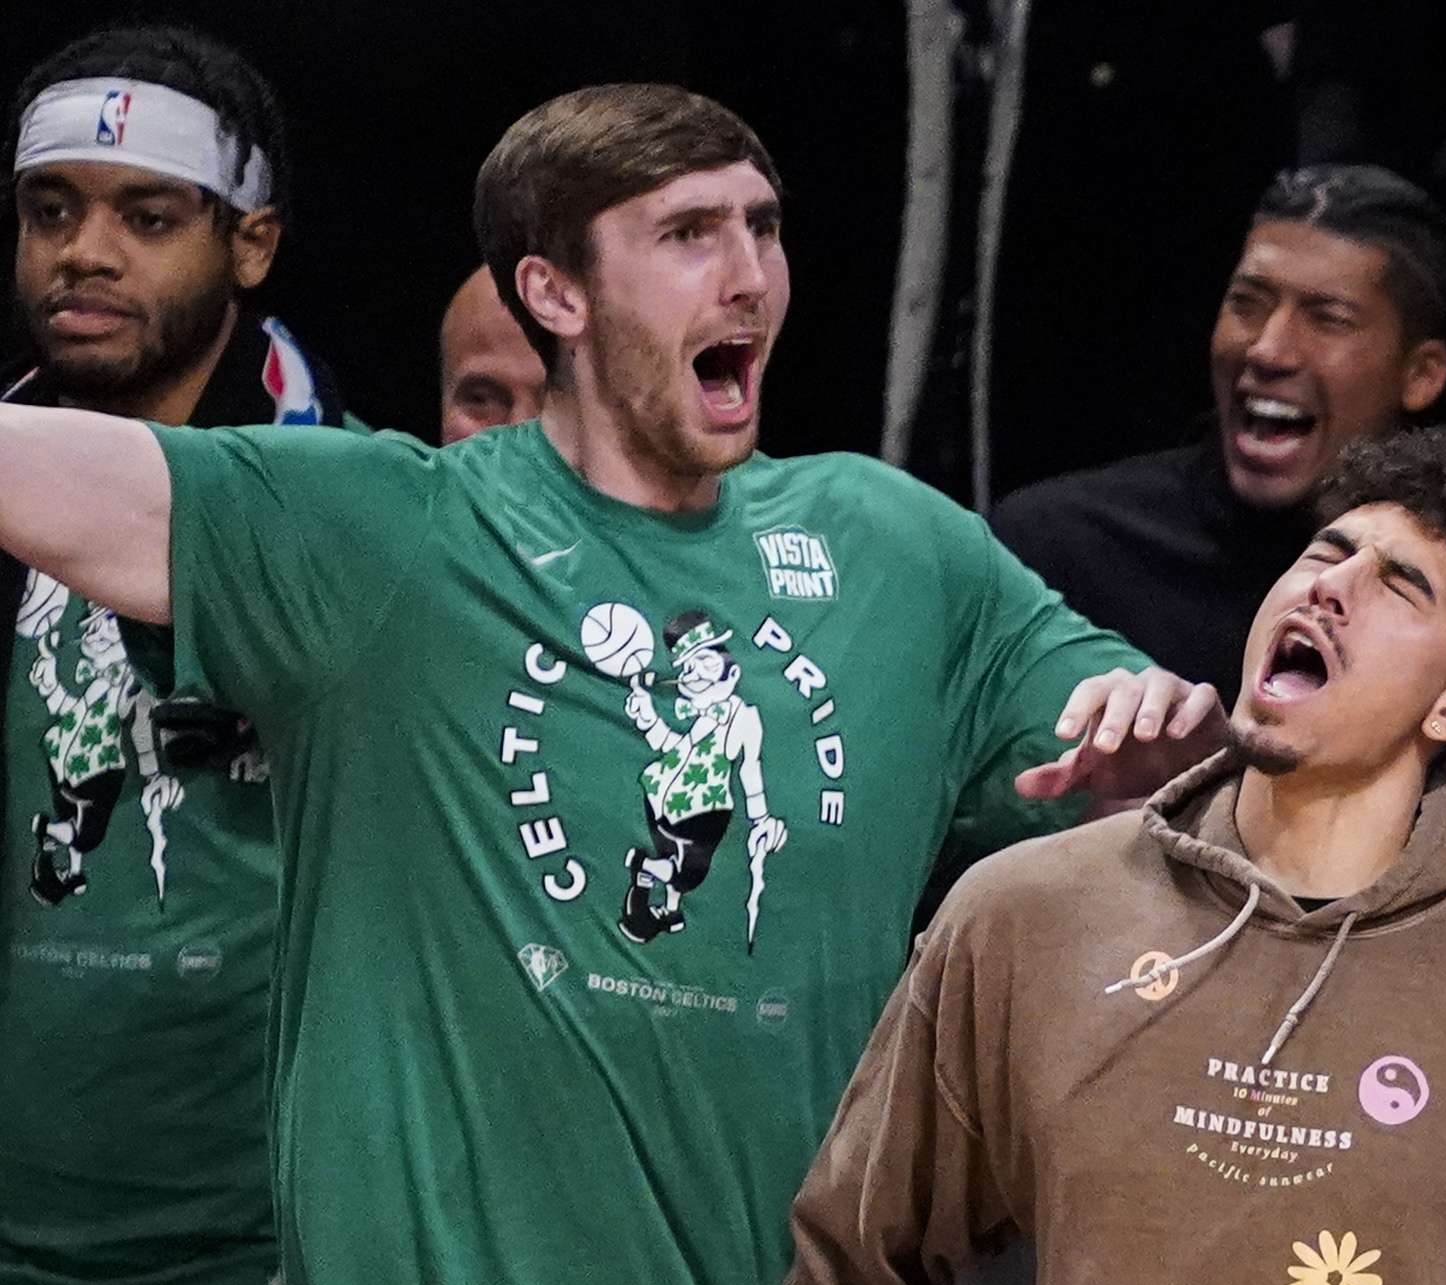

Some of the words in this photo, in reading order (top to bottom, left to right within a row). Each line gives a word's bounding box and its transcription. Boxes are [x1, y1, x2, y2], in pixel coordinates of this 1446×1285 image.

[759, 533, 831, 570] VISTA
[770, 569, 833, 596] PRINT
[752, 615, 845, 826] PRIDE
[501, 642, 586, 901] CELTIC
[587, 973, 667, 1002] BOSTON
[671, 990, 738, 1013] CELTICS
[1207, 1058, 1331, 1093] PRACTICE
[1233, 1087, 1248, 1099] 10
[1250, 1089, 1298, 1106] Minutes
[1258, 1106, 1272, 1117] of
[1173, 1105, 1353, 1150] MINDFULNESS
[1186, 1143, 1251, 1184] pacific
[1260, 1162, 1334, 1187] sunwear
[1231, 1140, 1299, 1164] Everyday
